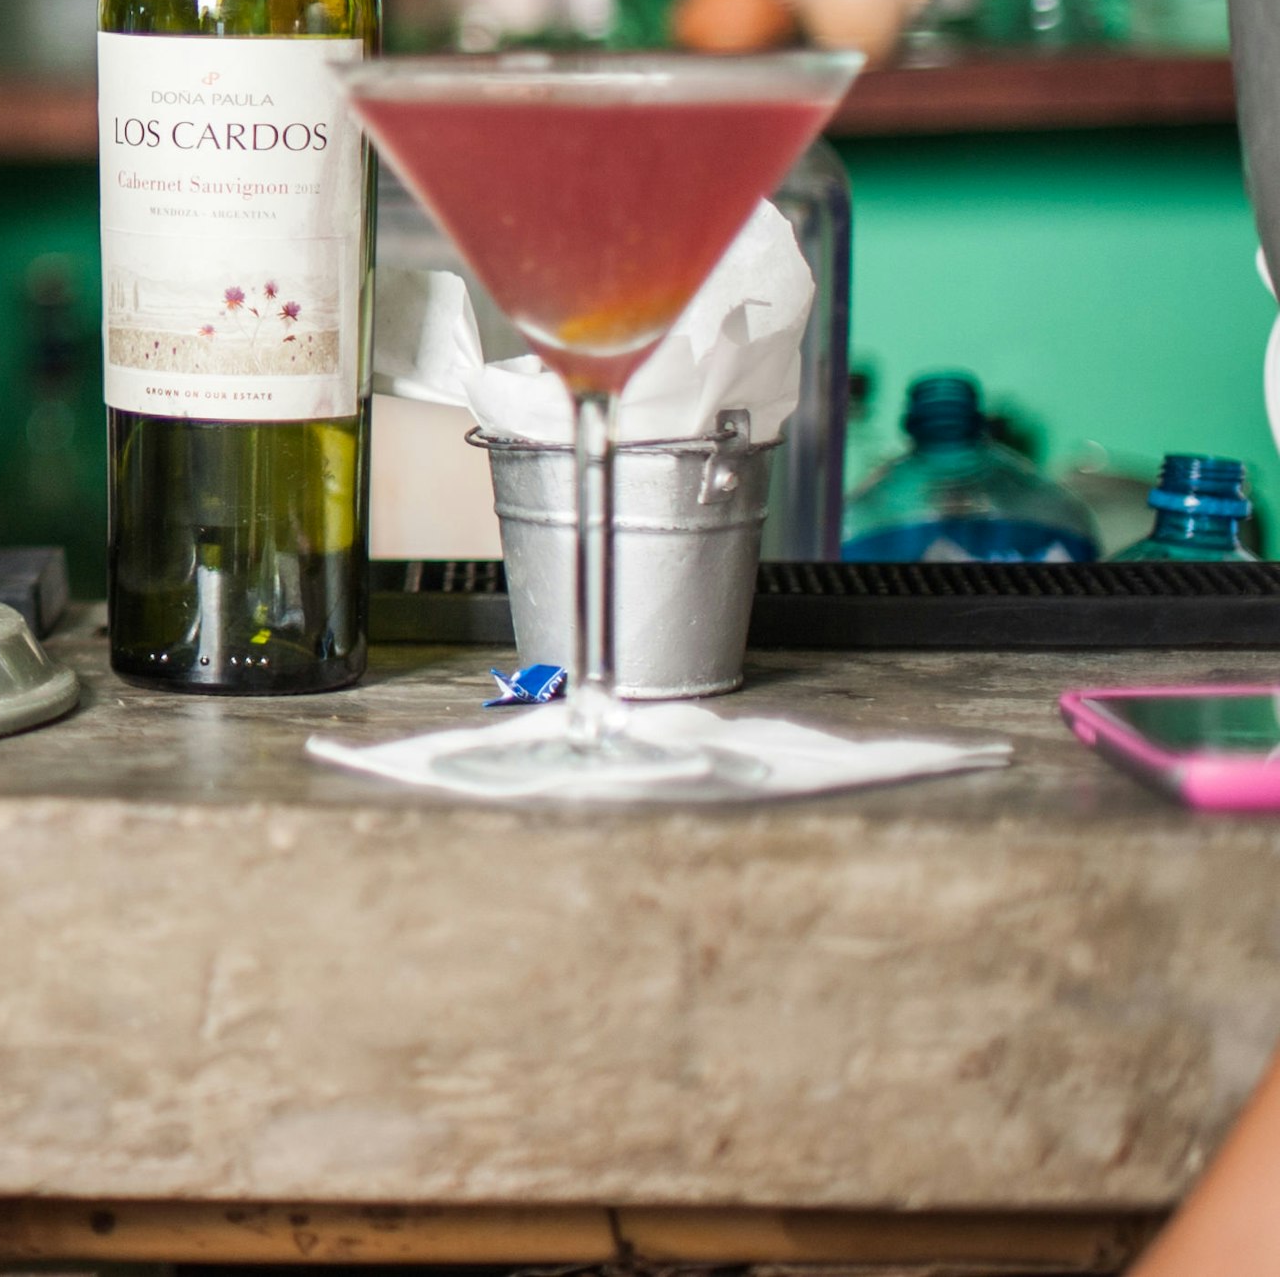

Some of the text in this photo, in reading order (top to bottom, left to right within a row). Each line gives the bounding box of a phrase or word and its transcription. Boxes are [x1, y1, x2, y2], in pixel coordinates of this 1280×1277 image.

[151, 90, 274, 107] DOÑA PAULA
[115, 117, 327, 152] LOS CARDOS
[118, 170, 321, 200] Cabernet Sauvignon 2012
[150, 206, 198, 217] MENDOZA
[210, 209, 277, 219] ARGENTINA
[146, 387, 179, 397] GROWN
[205, 391, 227, 400] OUR
[233, 393, 273, 401] ESTATE
